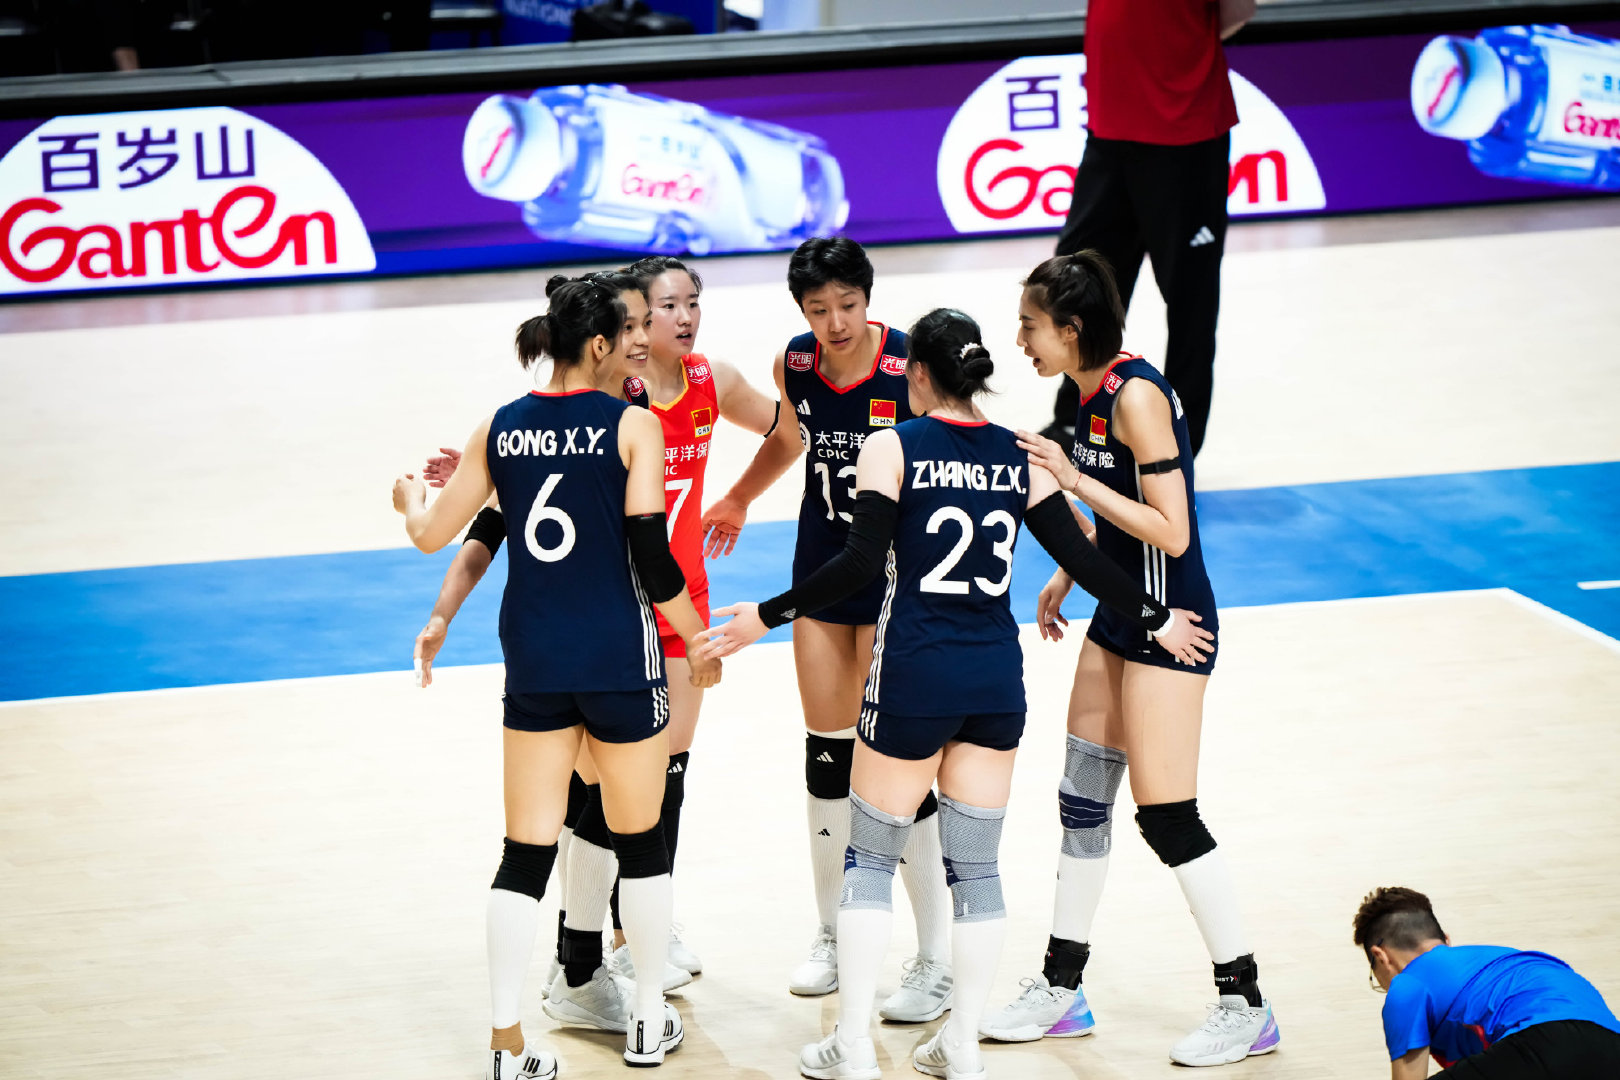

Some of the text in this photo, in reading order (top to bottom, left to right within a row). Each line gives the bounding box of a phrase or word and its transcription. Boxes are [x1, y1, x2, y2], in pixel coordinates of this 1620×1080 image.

[38, 126, 255, 193] 百岁山
[697, 426, 710, 435] CHN
[872, 417, 893, 425] CHN
[496, 426, 607, 458] GONG X.Y.
[817, 448, 850, 460] CPIC
[1090, 434, 1105, 444] CHN
[911, 460, 988, 491] ZHANG
[524, 473, 577, 563] 6
[919, 505, 1017, 597] 23
